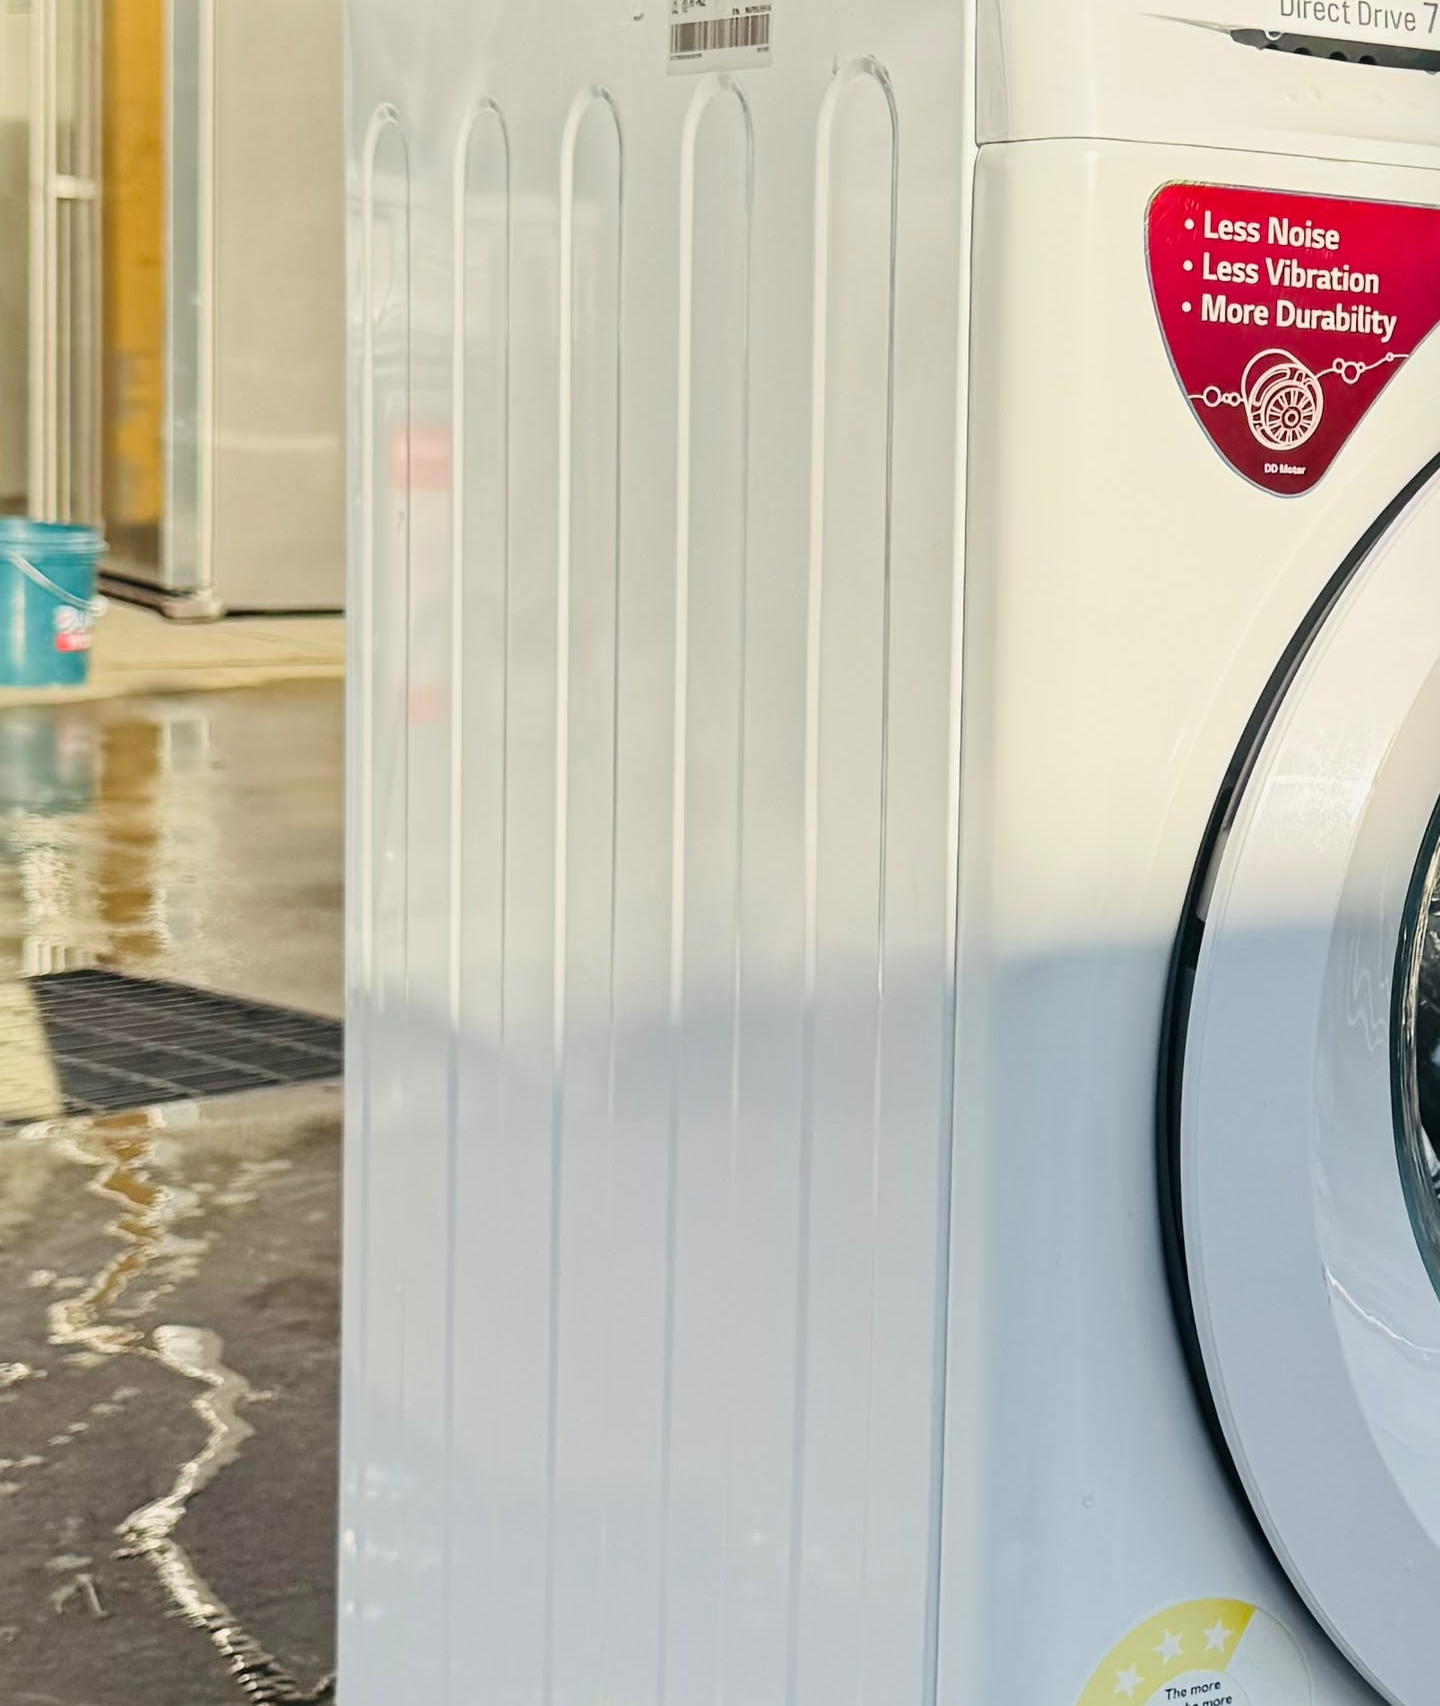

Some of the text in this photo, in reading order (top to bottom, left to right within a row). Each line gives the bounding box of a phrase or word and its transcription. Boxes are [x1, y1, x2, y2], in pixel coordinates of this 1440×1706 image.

[1358, 1, 1416, 33] Drive
[1203, 210, 1339, 251] Less Noise
[1202, 252, 1379, 294] Less Vibration
[1201, 294, 1397, 343] More Durability
[1264, 463, 1278, 474] DD
[1165, 1679, 1221, 1701] The more
